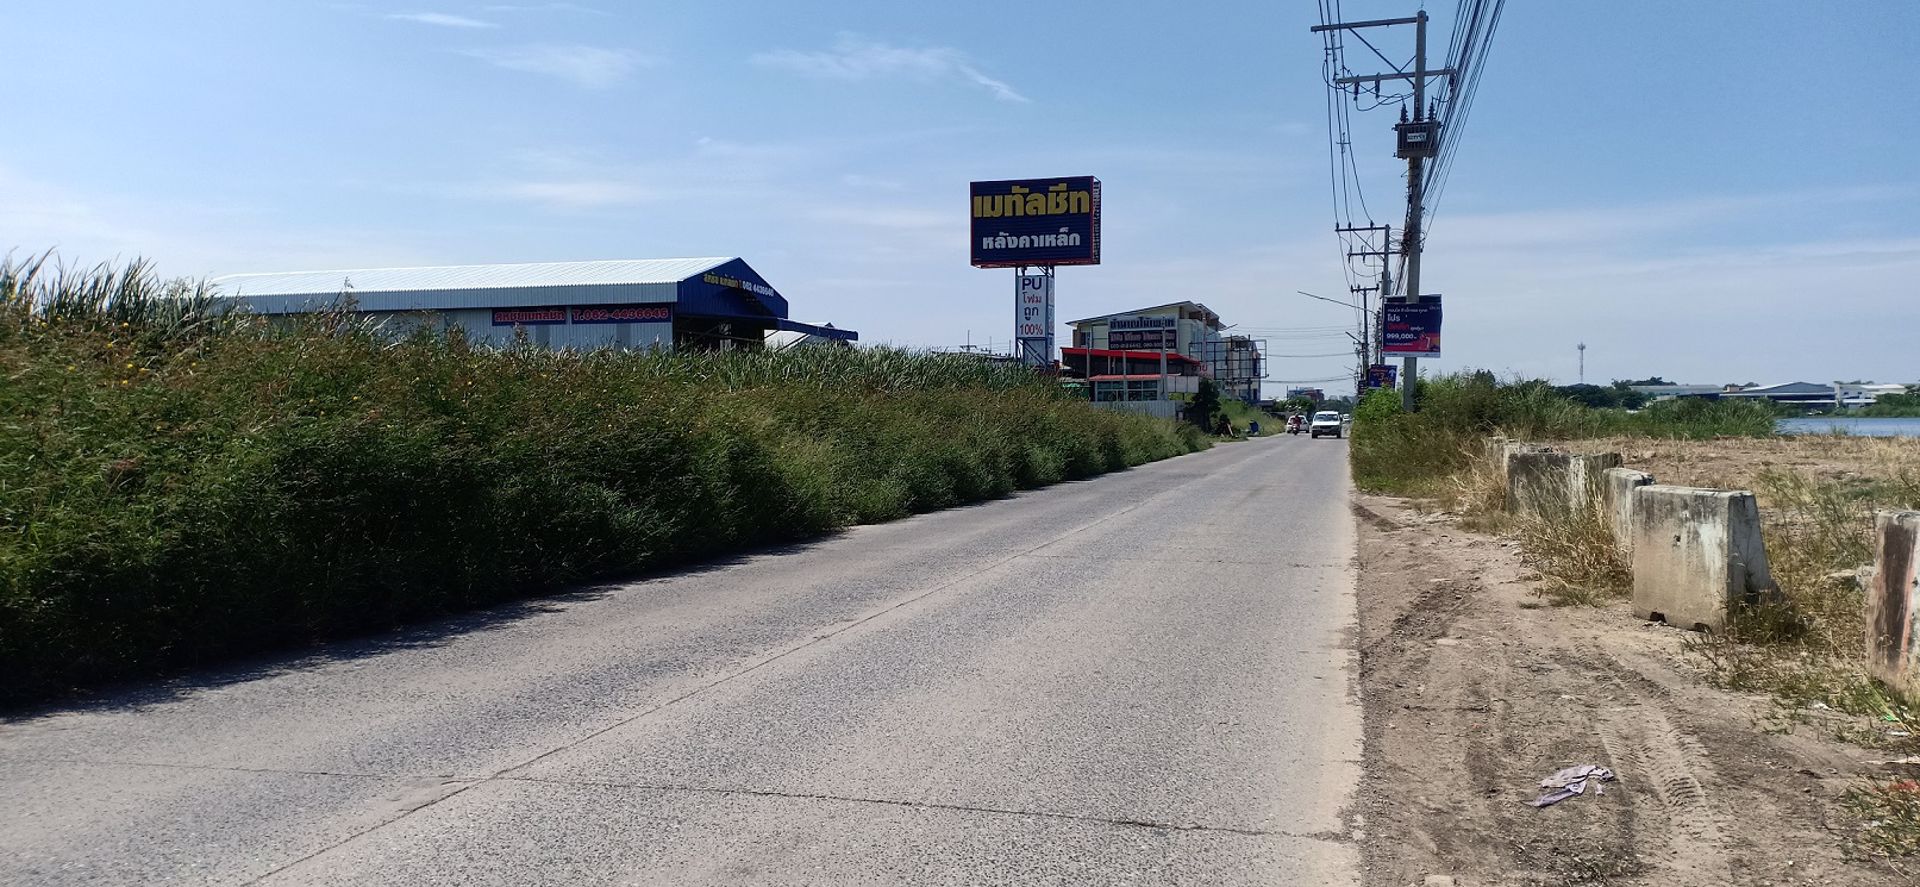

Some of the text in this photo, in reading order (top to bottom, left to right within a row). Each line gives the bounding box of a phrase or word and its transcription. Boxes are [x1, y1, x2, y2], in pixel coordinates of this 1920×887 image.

[973, 183, 1090, 218] เมทัลชีท
[982, 227, 1081, 250] หลังคาเหล็ก
[1021, 277, 1042, 290] PU
[1022, 291, 1042, 303] โฟม
[1024, 306, 1039, 319] ถูก
[1019, 323, 1043, 335] 100%
